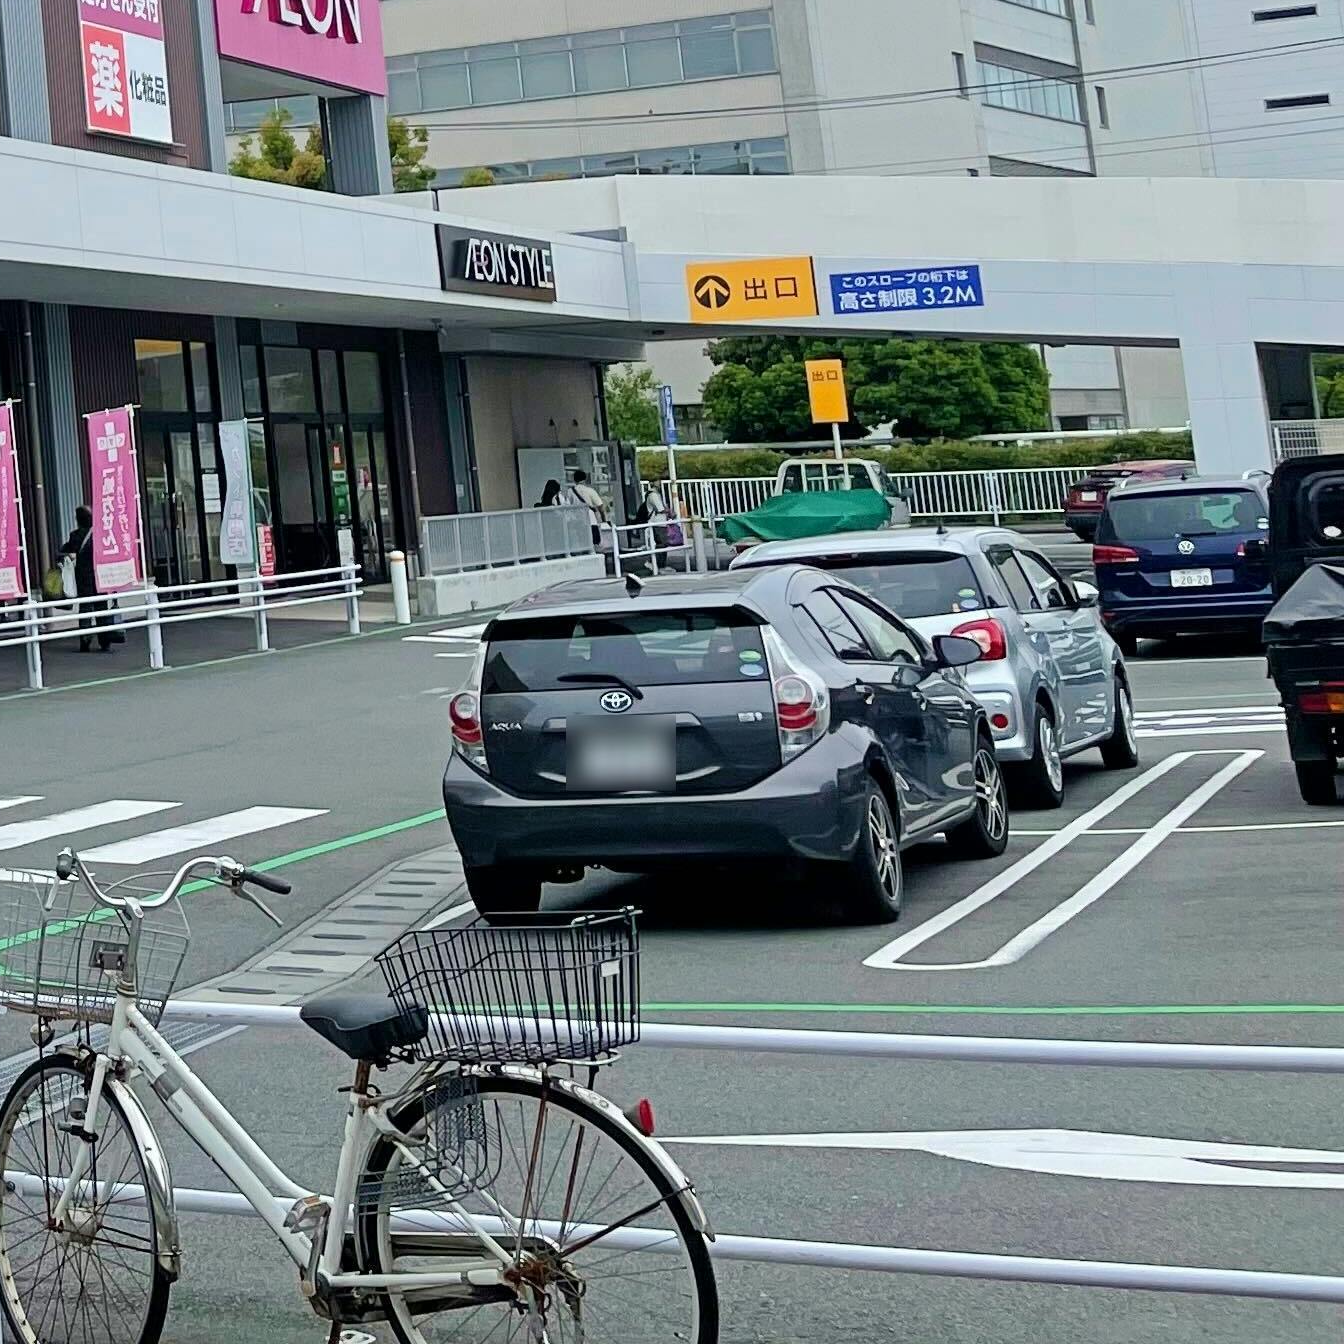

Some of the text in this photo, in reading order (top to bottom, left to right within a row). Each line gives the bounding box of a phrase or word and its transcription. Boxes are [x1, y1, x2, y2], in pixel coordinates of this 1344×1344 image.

[90, 41, 124, 118] 薬
[129, 68, 167, 107] 化粧品
[508, 243, 554, 289] STYLE
[744, 275, 799, 302] 出口
[839, 284, 977, 311] 高さ制限 3.2M
[811, 370, 839, 382] 出口
